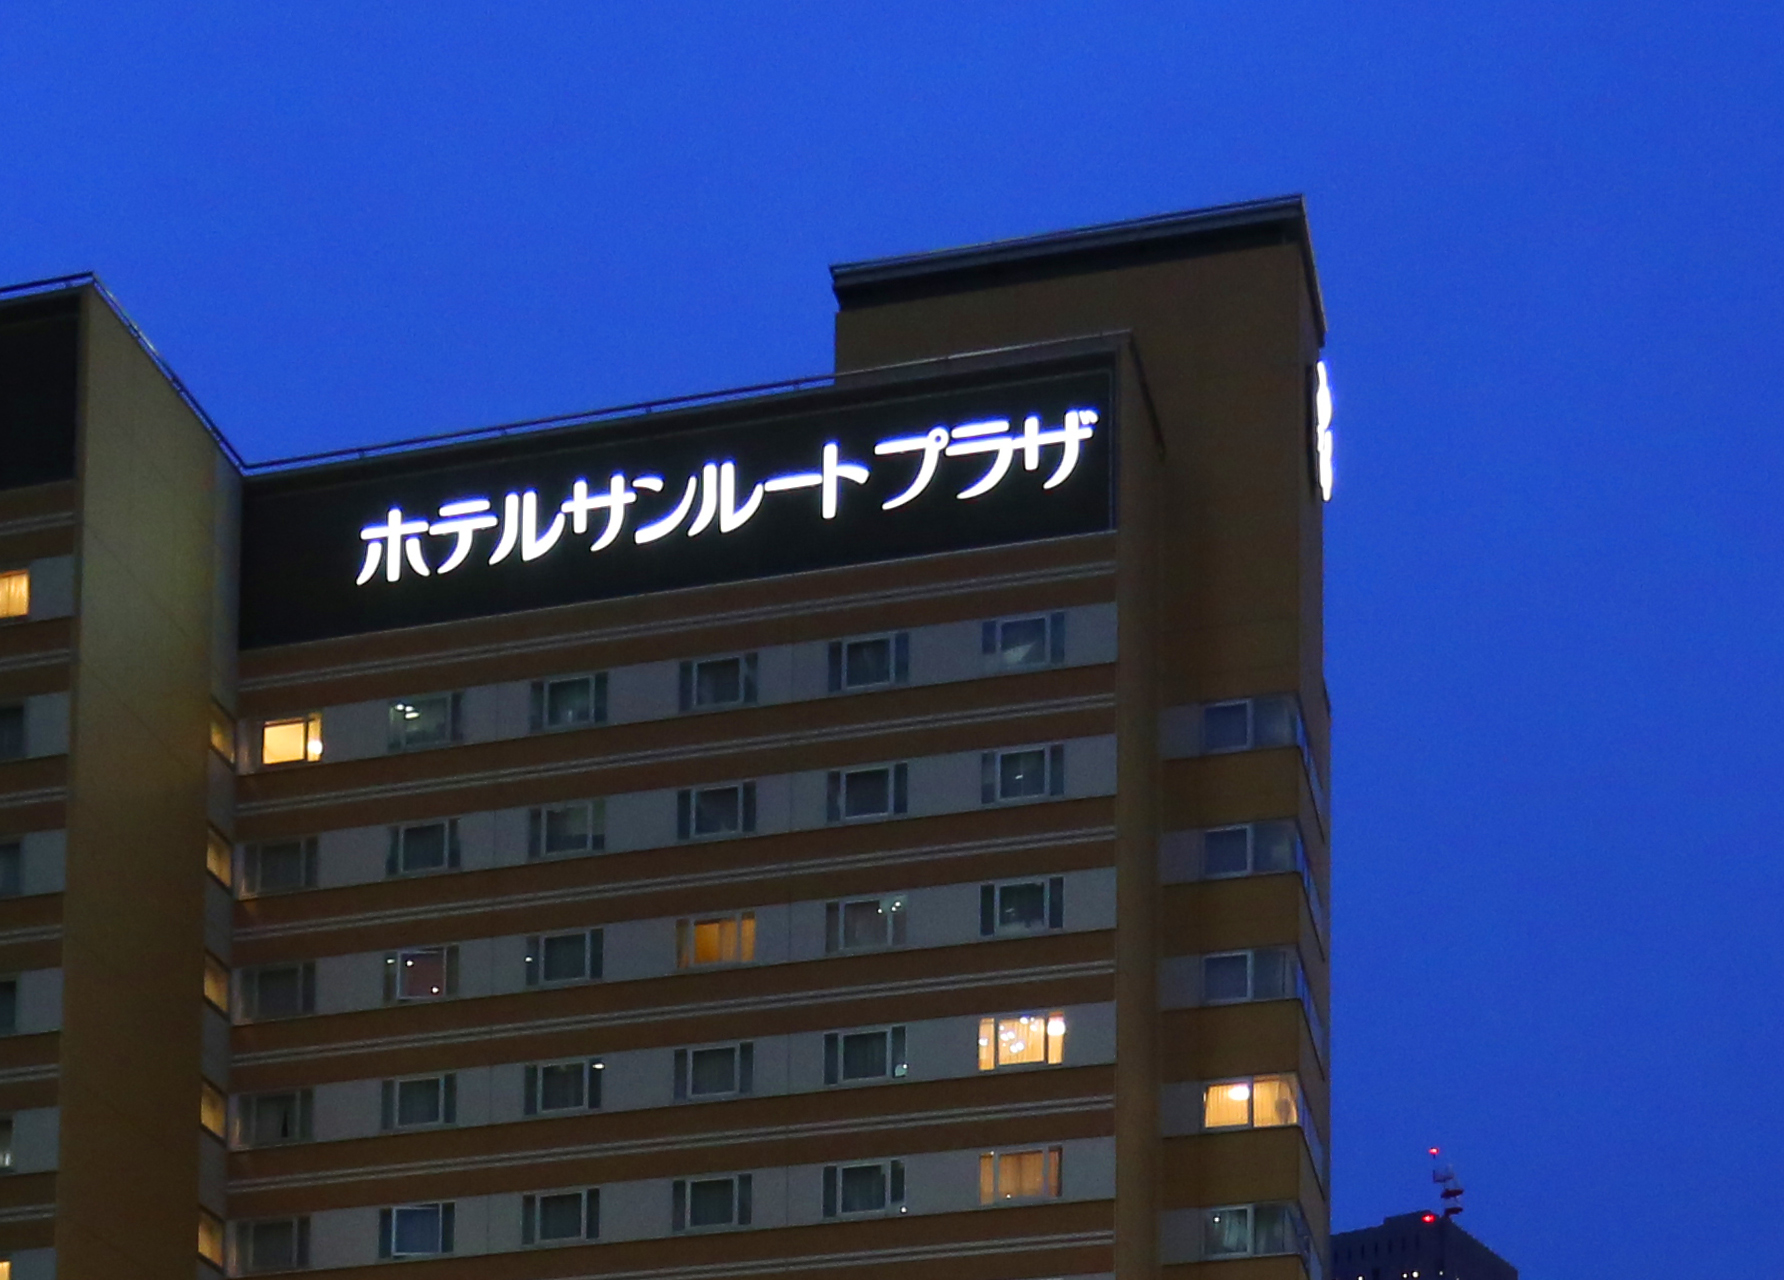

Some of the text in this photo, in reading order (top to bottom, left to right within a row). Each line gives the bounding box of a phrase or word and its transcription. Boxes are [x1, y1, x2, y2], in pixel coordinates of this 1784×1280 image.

[356, 408, 1099, 585] ホテルサンルートプラザ
